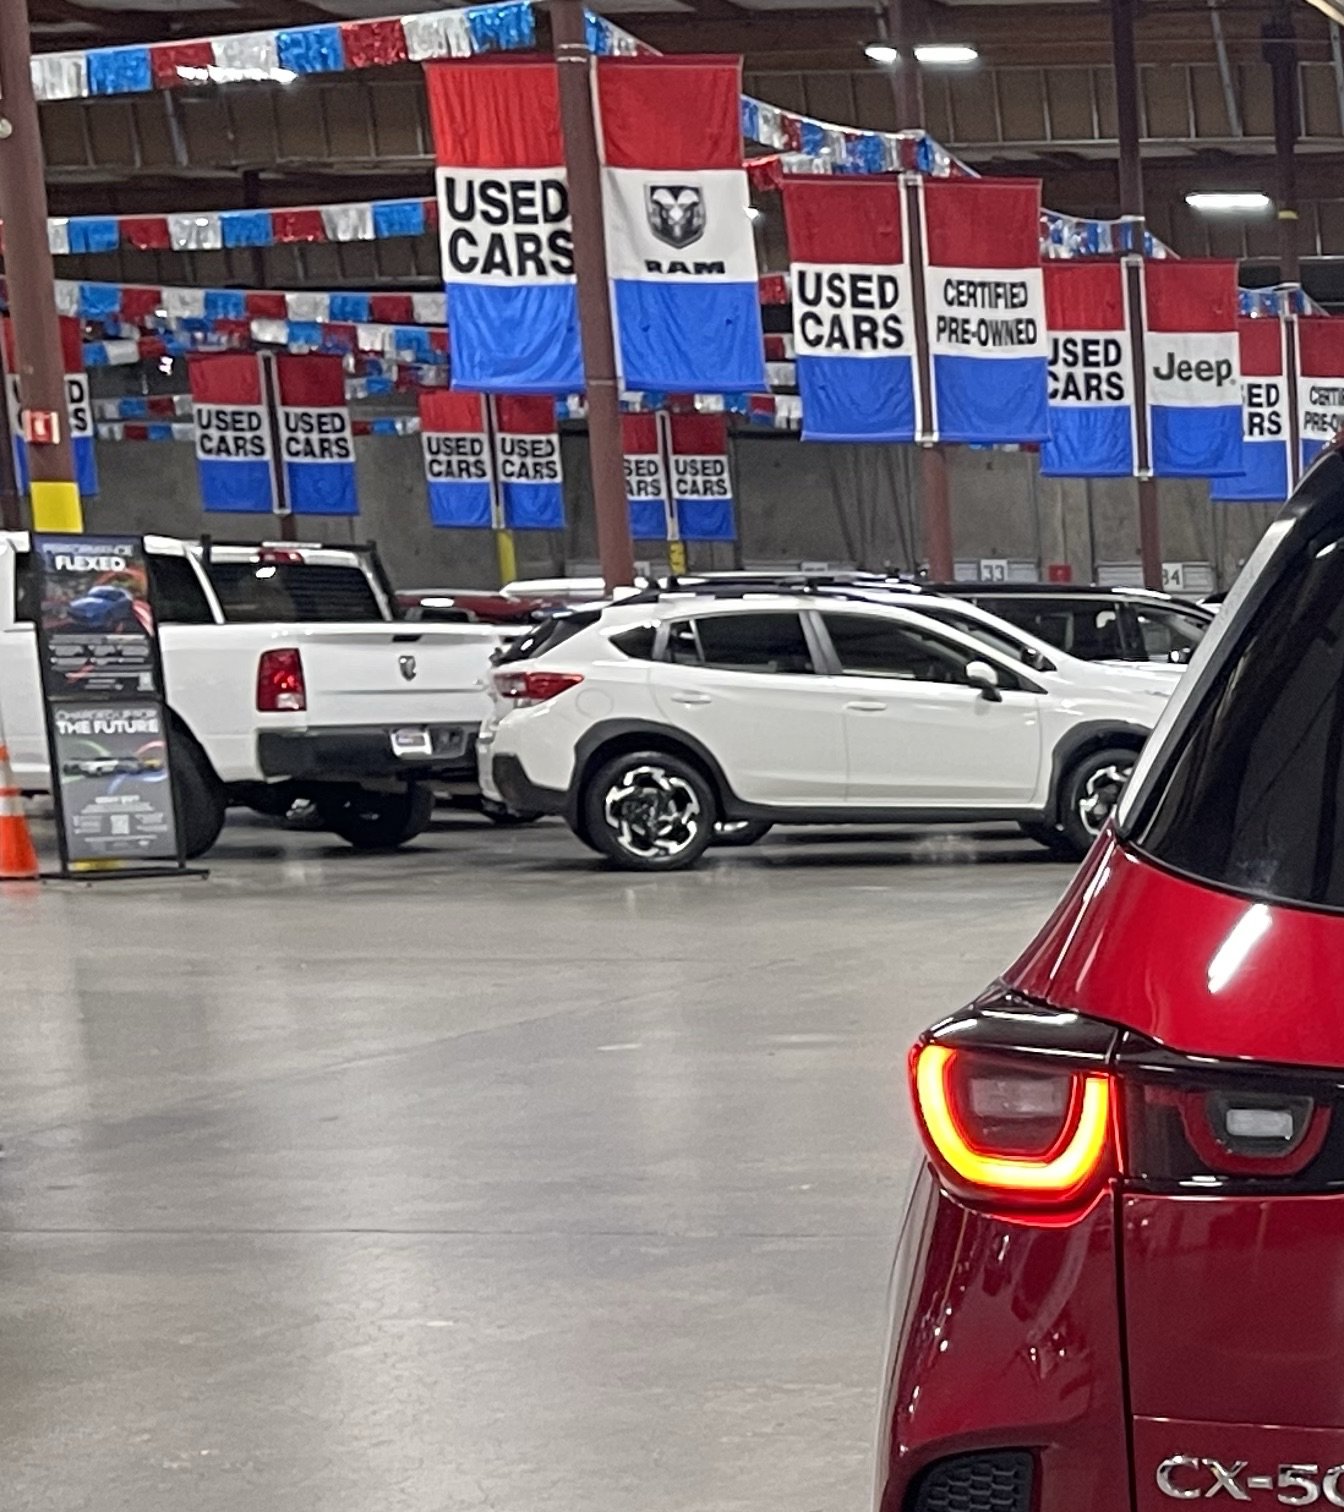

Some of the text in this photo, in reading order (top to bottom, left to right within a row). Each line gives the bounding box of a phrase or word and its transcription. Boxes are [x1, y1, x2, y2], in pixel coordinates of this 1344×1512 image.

[445, 177, 568, 225] USED
[448, 228, 575, 276] CARS
[644, 259, 726, 275] RAM
[797, 270, 899, 309] USED
[943, 279, 1028, 309] CERTIFIED
[799, 311, 904, 350] CARS
[936, 316, 1038, 347] PRE-OWNED
[1153, 352, 1232, 386] Jeep
[197, 409, 262, 432] USED
[284, 412, 345, 434] USED
[200, 434, 265, 457] CARS
[285, 437, 350, 459] CARS
[426, 437, 484, 456] USED
[501, 437, 556, 458] USED
[428, 459, 487, 479] CARS
[502, 459, 558, 479] CARS
[623, 459, 659, 477] SED
[674, 459, 725, 477] USED
[625, 479, 662, 497] ARS
[676, 478, 728, 496] CARS
